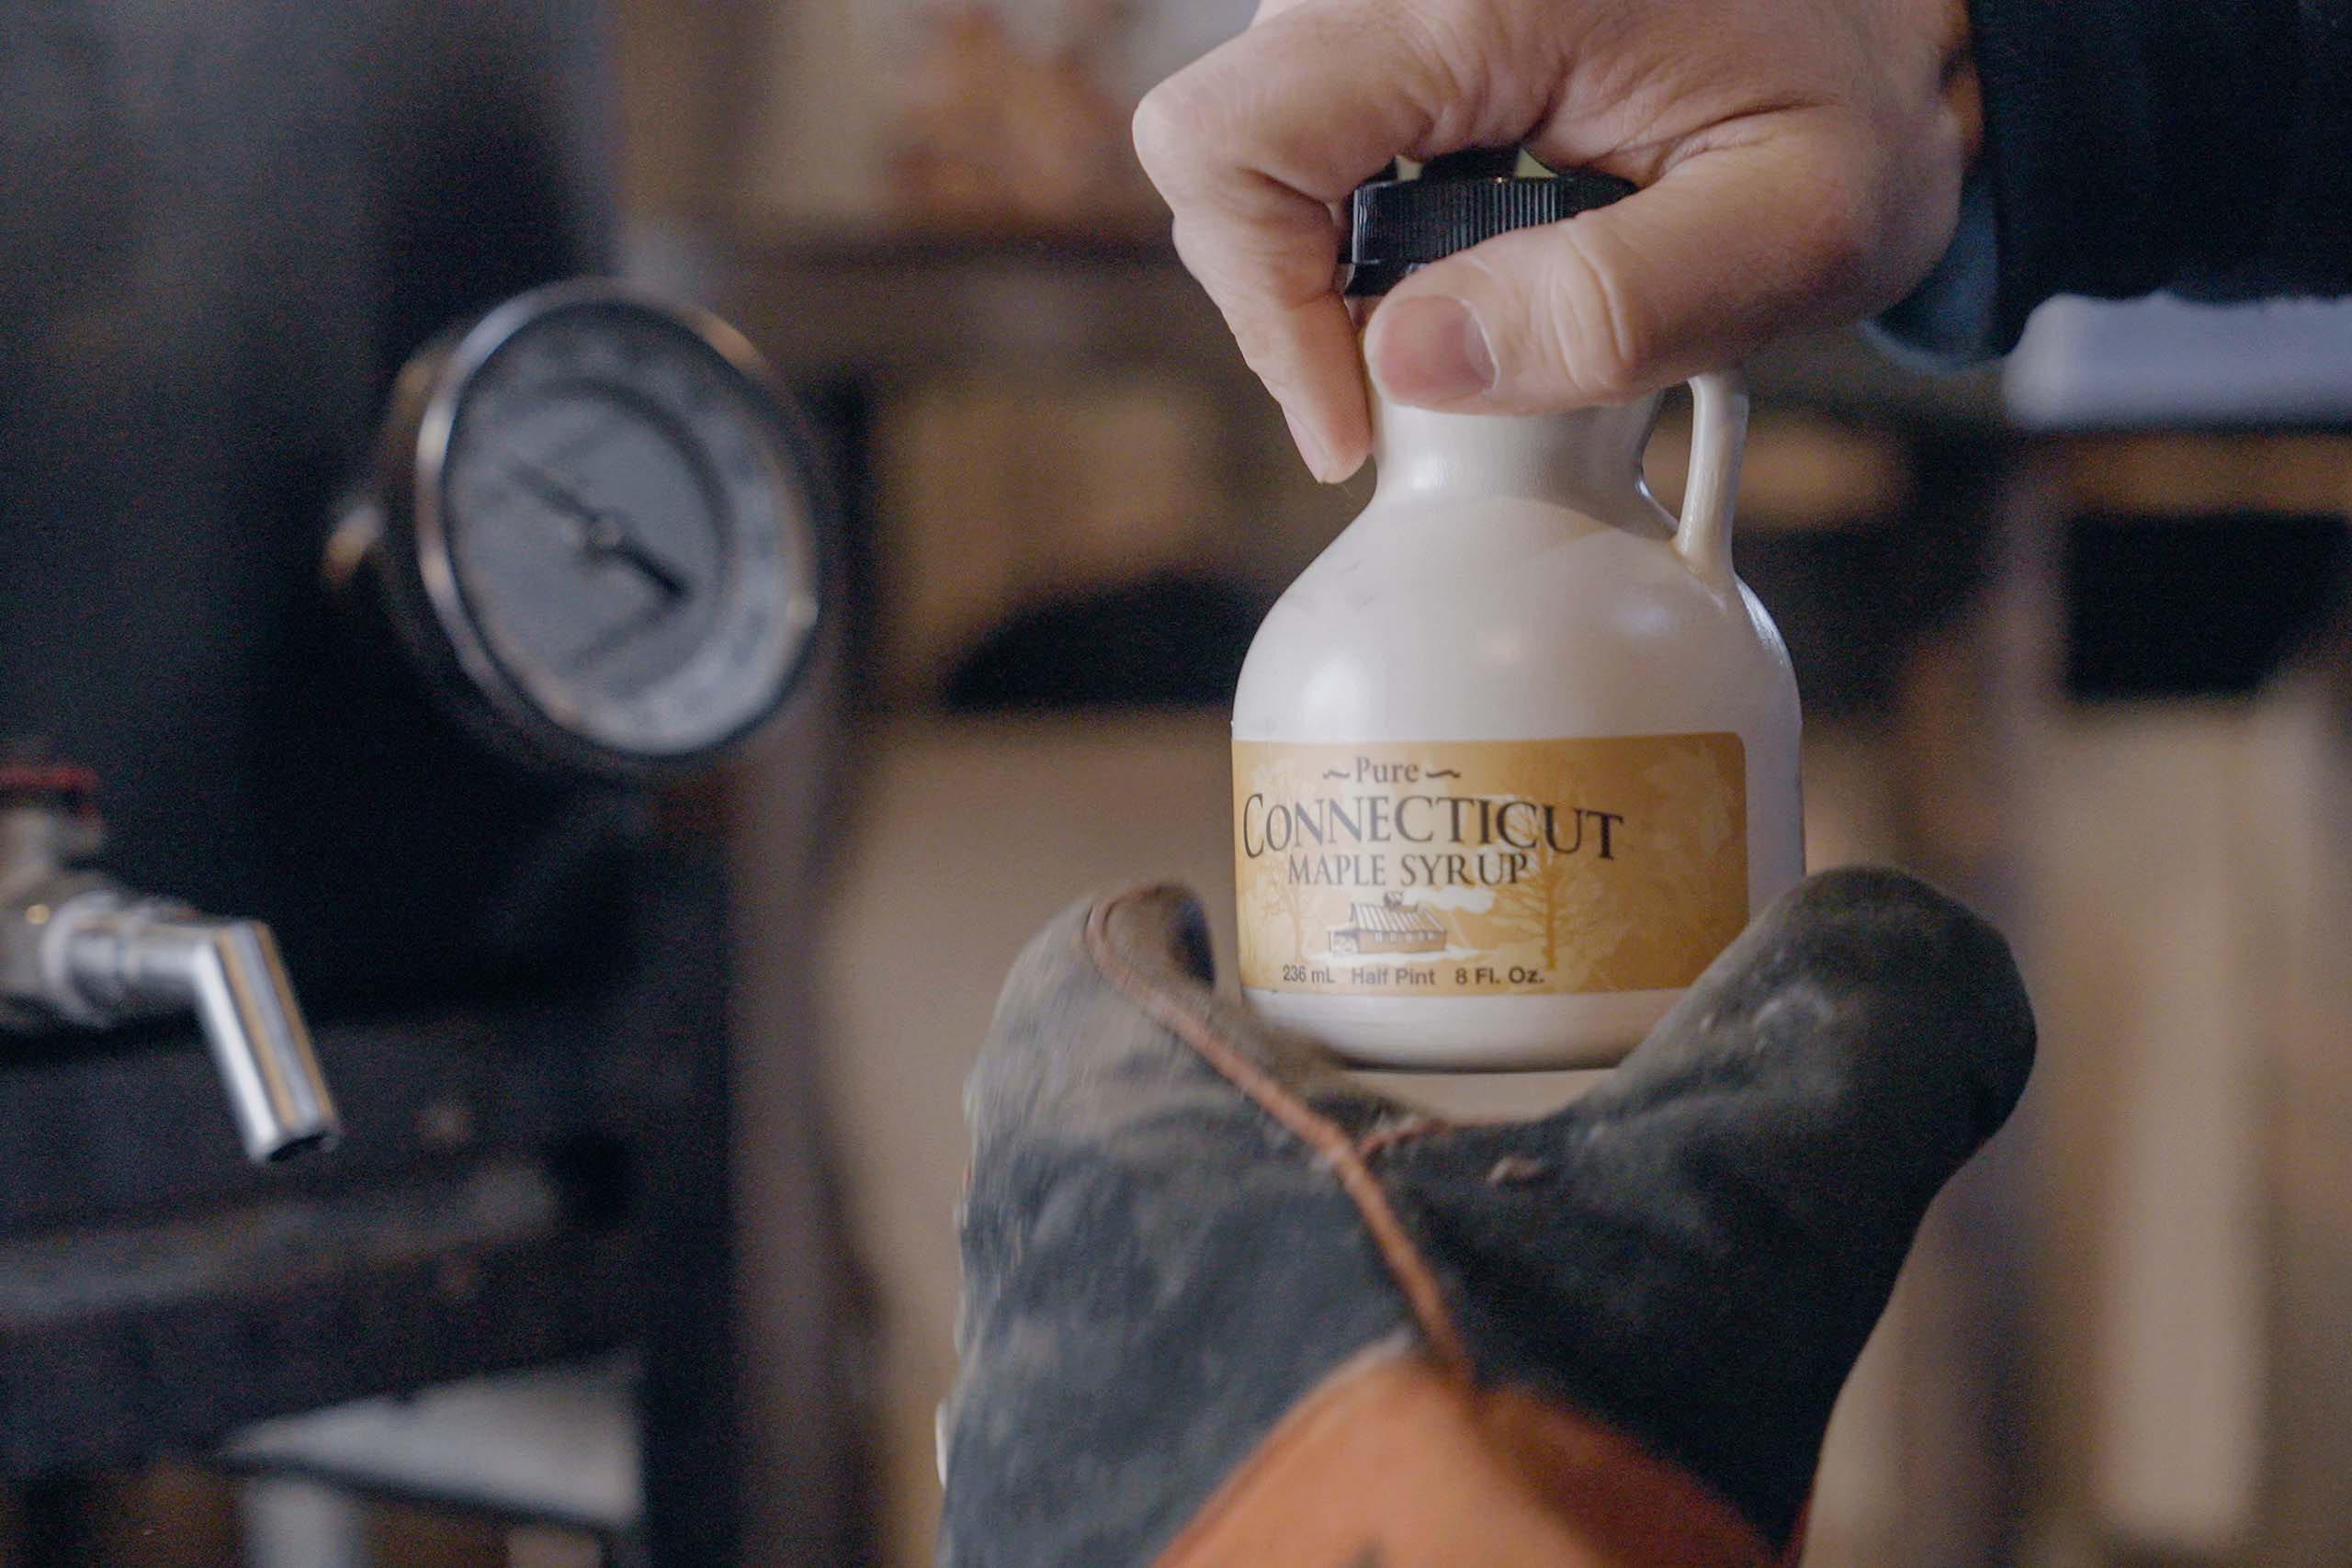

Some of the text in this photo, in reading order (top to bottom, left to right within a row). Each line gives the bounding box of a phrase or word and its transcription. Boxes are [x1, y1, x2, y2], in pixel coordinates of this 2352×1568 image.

[1355, 756, 1419, 783] Pure
[1243, 793, 1624, 861] CONNECTICUT
[1288, 853, 1528, 886] MAPLE SYRUP
[1283, 965, 1545, 985] 236 mL Half Pint 8 Fl. Oz.
